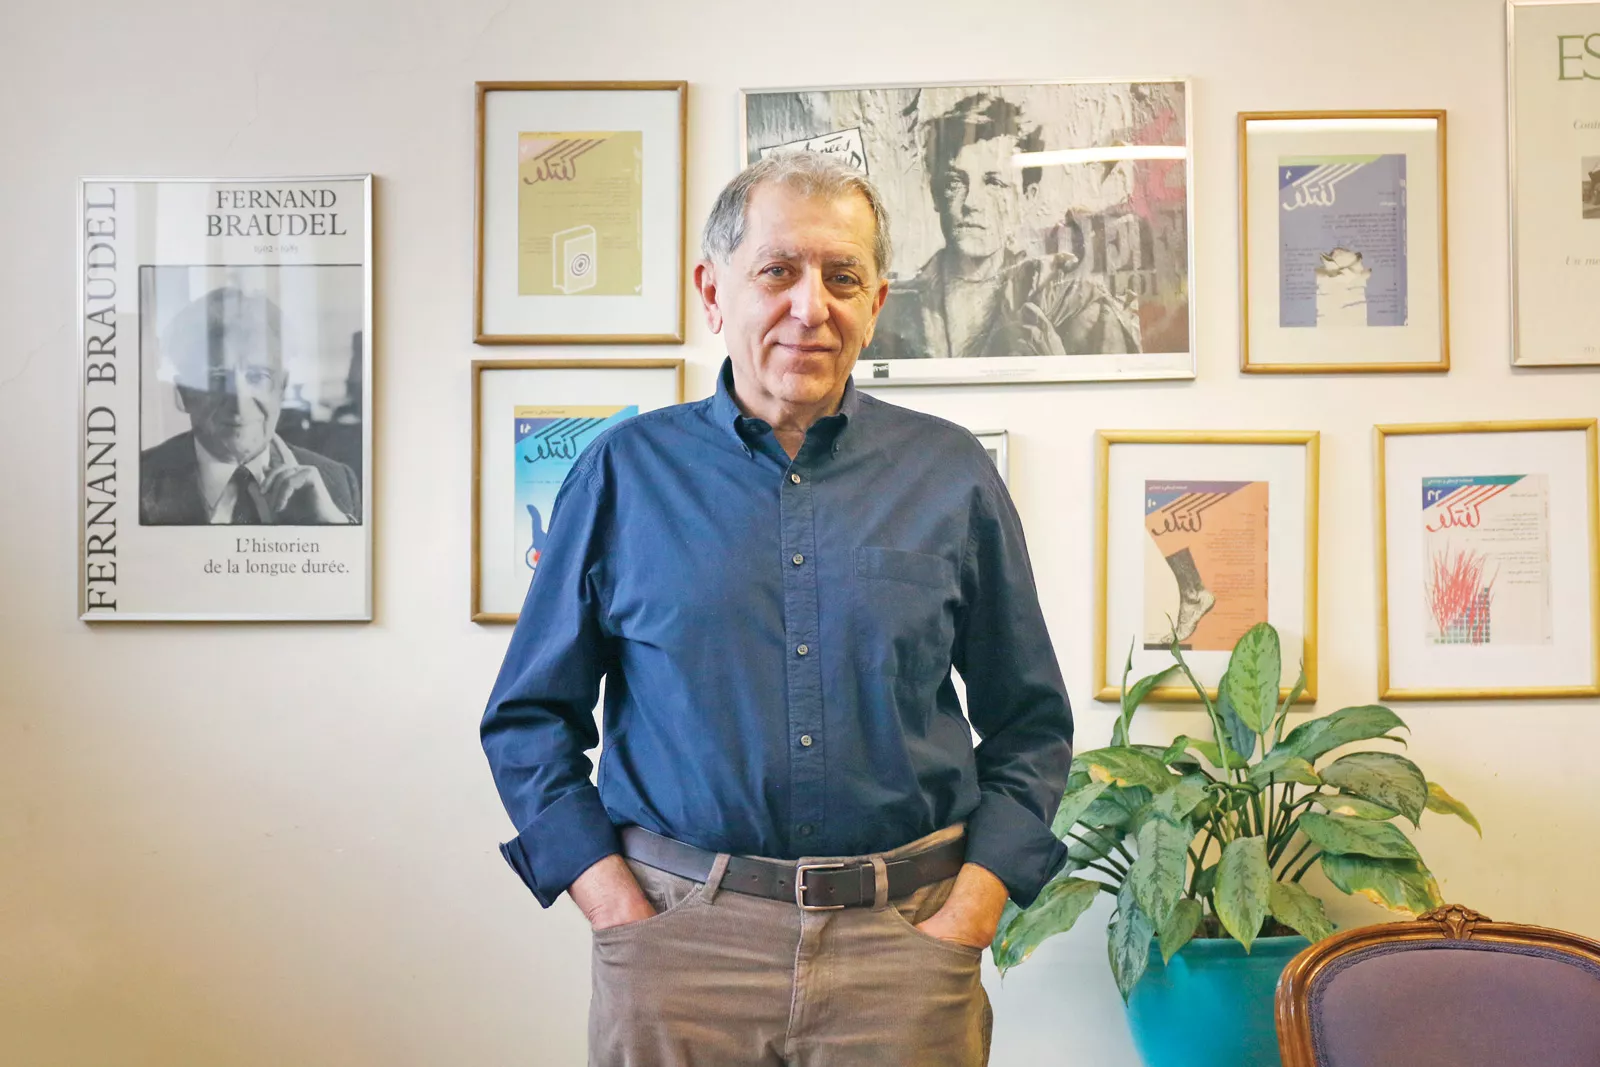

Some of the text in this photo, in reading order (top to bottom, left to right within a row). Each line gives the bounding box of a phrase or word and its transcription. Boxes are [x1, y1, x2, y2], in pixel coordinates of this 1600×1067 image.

[215, 189, 337, 209] FERNAND
[206, 213, 347, 237] BRAUDEL
[87, 187, 117, 612] FERNAND BRAUDEL
[203, 559, 350, 576] de la longue durée.
